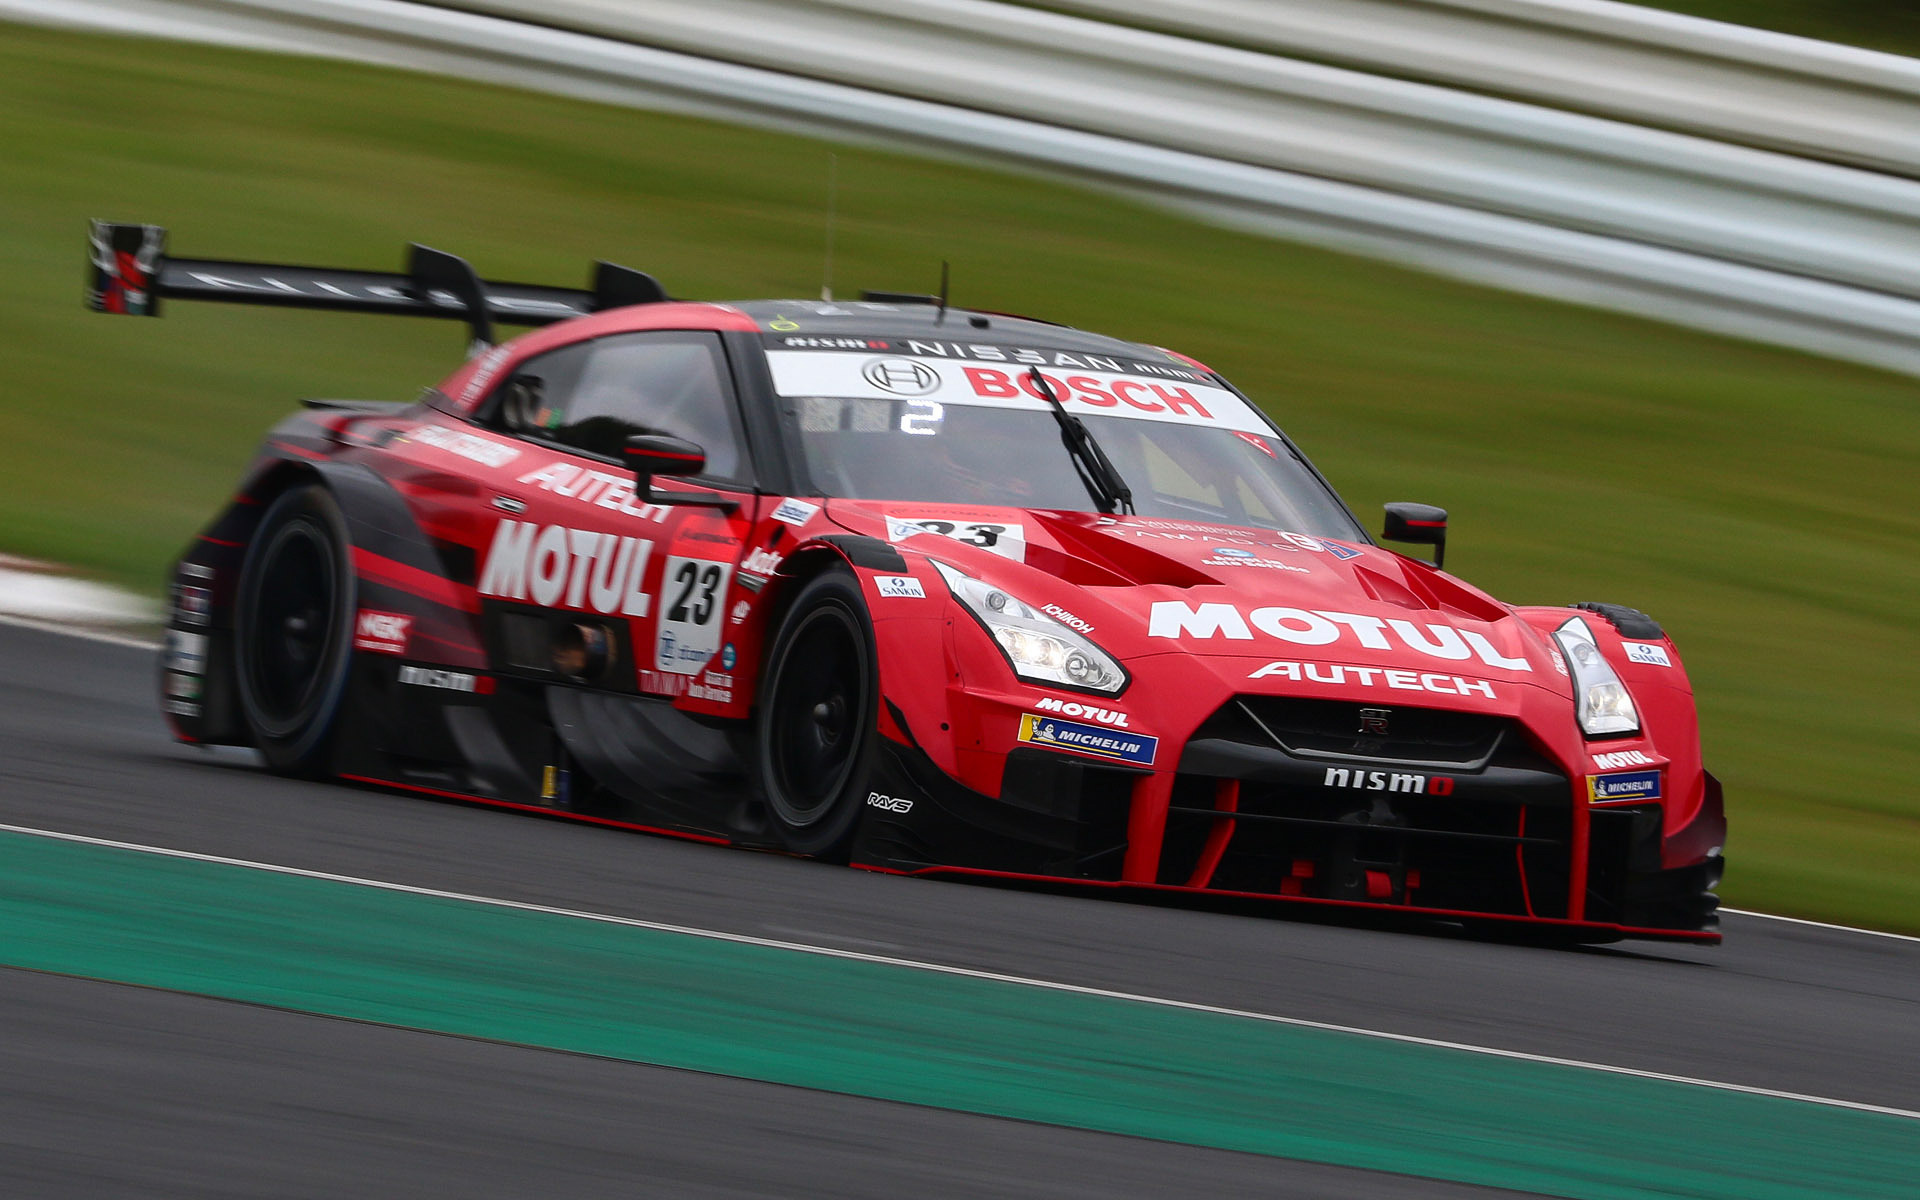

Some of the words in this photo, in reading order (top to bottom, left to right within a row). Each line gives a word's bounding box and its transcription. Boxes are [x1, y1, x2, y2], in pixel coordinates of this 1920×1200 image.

[907, 340, 1125, 372] NISSAN
[961, 366, 1215, 419] BOSCH
[901, 399, 944, 435] 2
[478, 518, 655, 617] MOTUL
[667, 561, 721, 625] 23
[882, 587, 922, 597] SANKIN
[1041, 603, 1095, 634] ICHIKOH
[1148, 601, 1533, 672] MOTUL
[1247, 661, 1498, 699] AUTECH
[1035, 697, 1128, 727] MOTUL
[1058, 730, 1140, 753] MICHELIN
[1592, 751, 1654, 769] MOTUL
[1324, 767, 1454, 796] nismo
[1608, 780, 1653, 793] MICHELIN
[868, 792, 913, 812] RAYS
